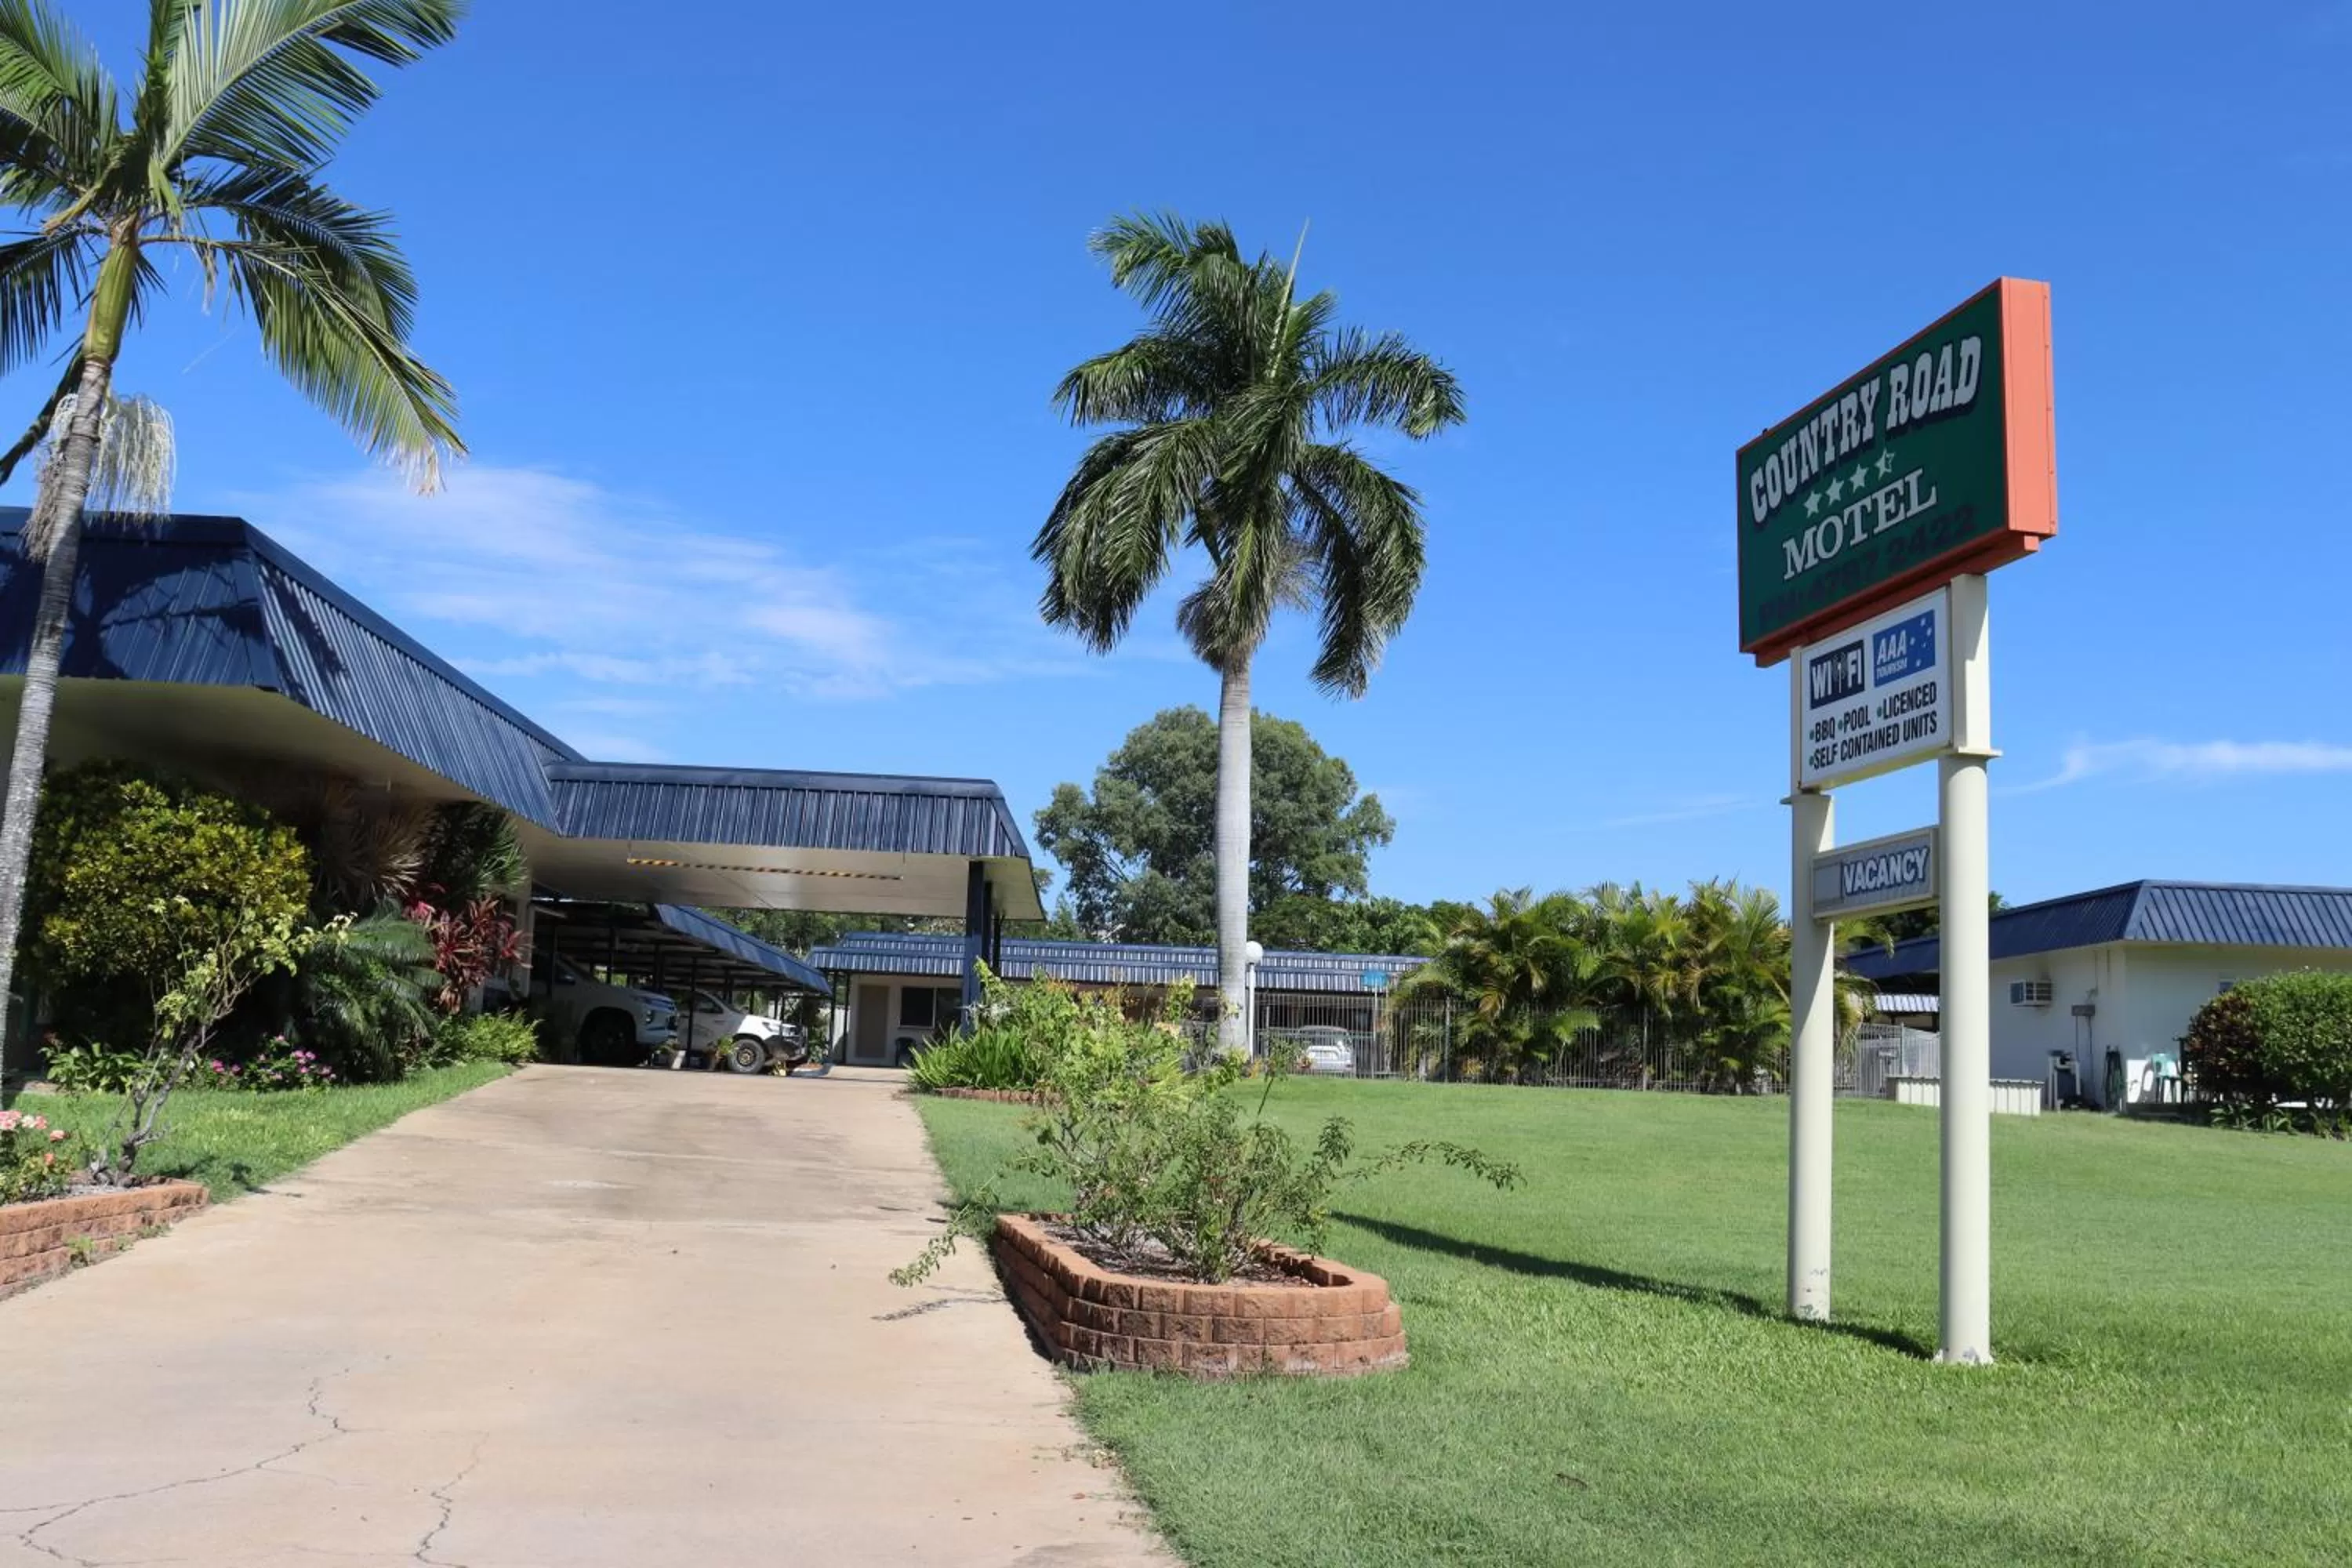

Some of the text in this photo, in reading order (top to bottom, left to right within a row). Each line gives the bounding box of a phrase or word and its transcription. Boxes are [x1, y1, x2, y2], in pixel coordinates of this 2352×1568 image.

[1750, 336, 1982, 524] COUNTRY ROAD
[1782, 468, 1938, 581] MOTEL
[1876, 630, 1907, 665] AAA
[1882, 681, 1937, 720] LICENCED
[1813, 710, 1937, 770] SELF CONTAINED UNITS
[1843, 845, 1929, 895] VACANCY
